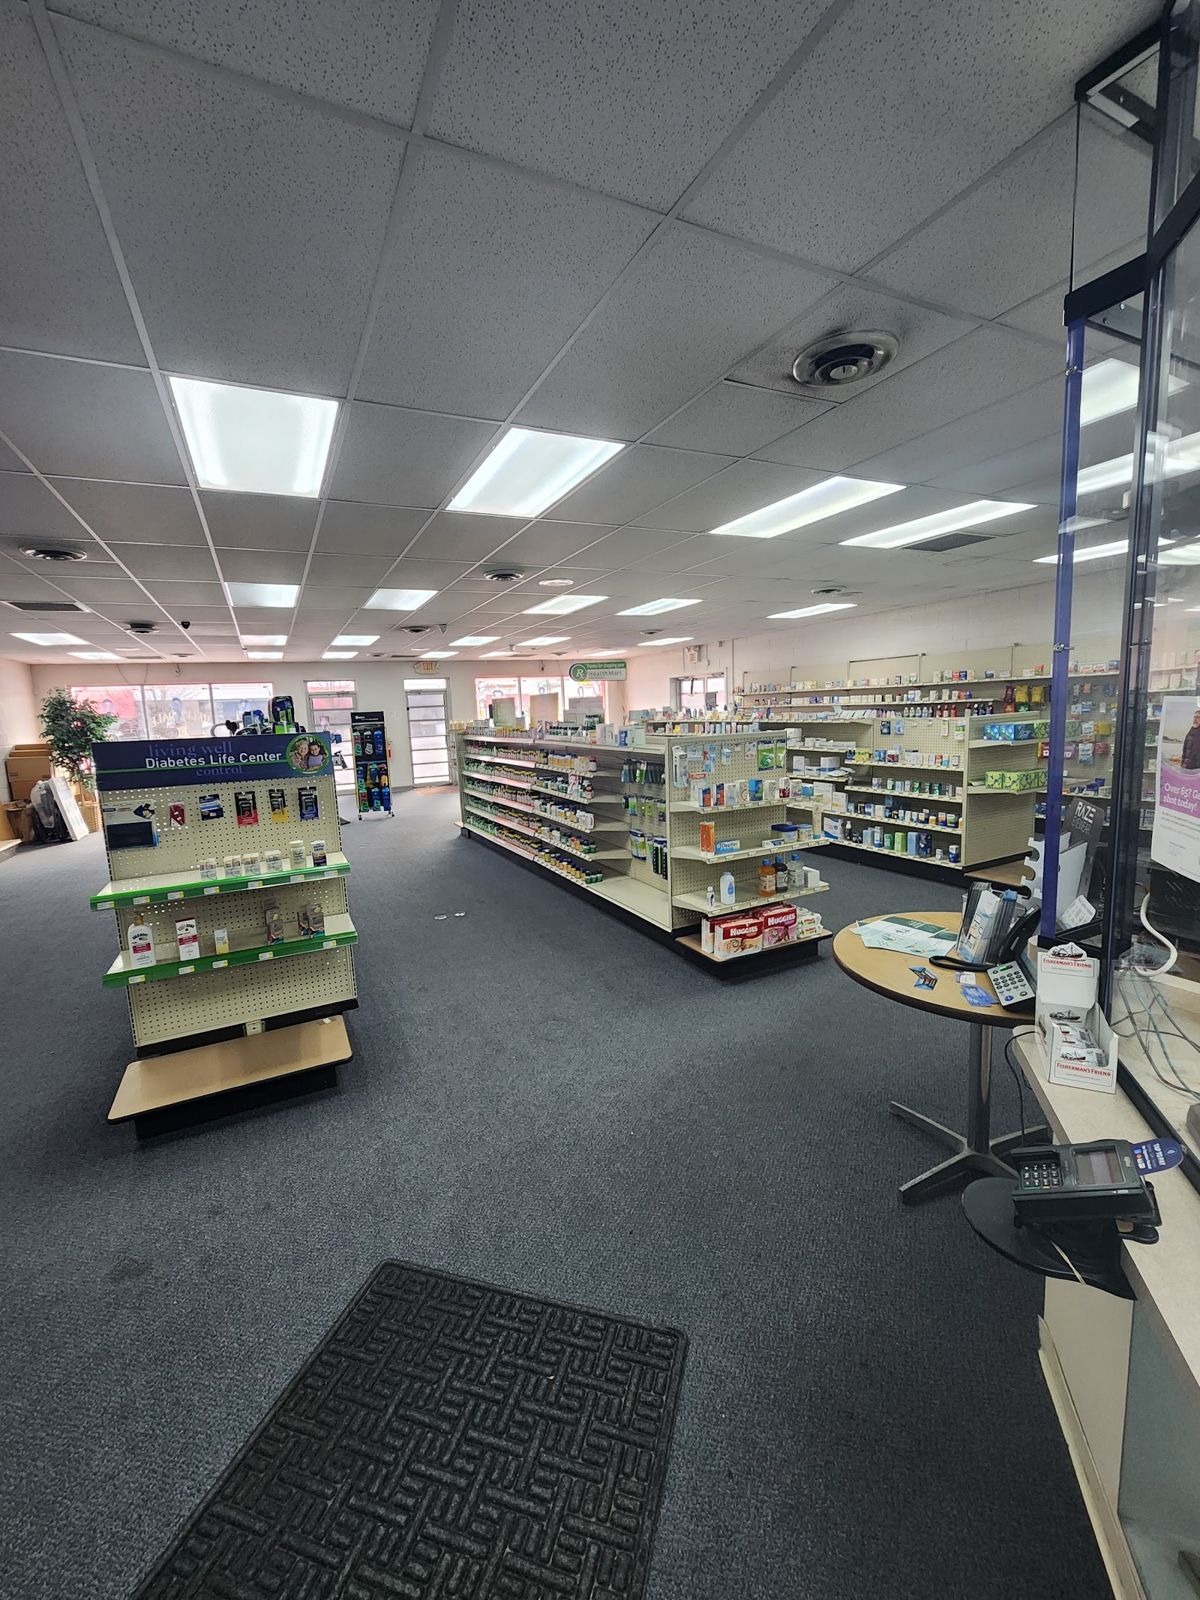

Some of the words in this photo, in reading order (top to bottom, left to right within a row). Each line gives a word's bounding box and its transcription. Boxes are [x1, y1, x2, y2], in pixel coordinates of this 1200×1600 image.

[149, 744, 197, 757] living
[201, 741, 232, 754] well
[145, 756, 205, 769] Diabetes
[209, 753, 235, 765] Life
[239, 752, 282, 763] Center
[196, 765, 243, 777] control
[1164, 782, 1181, 794] Over
[1181, 786, 1192, 798] 65?
[1163, 794, 1177, 803] shot
[1177, 798, 1198, 812] today!
[1075, 801, 1097, 824] RAZE
[1074, 961, 1092, 969] FRIEND
[1056, 1062, 1091, 1074] FISHERMAN'S
[1091, 1068, 1112, 1077] FRIEND
